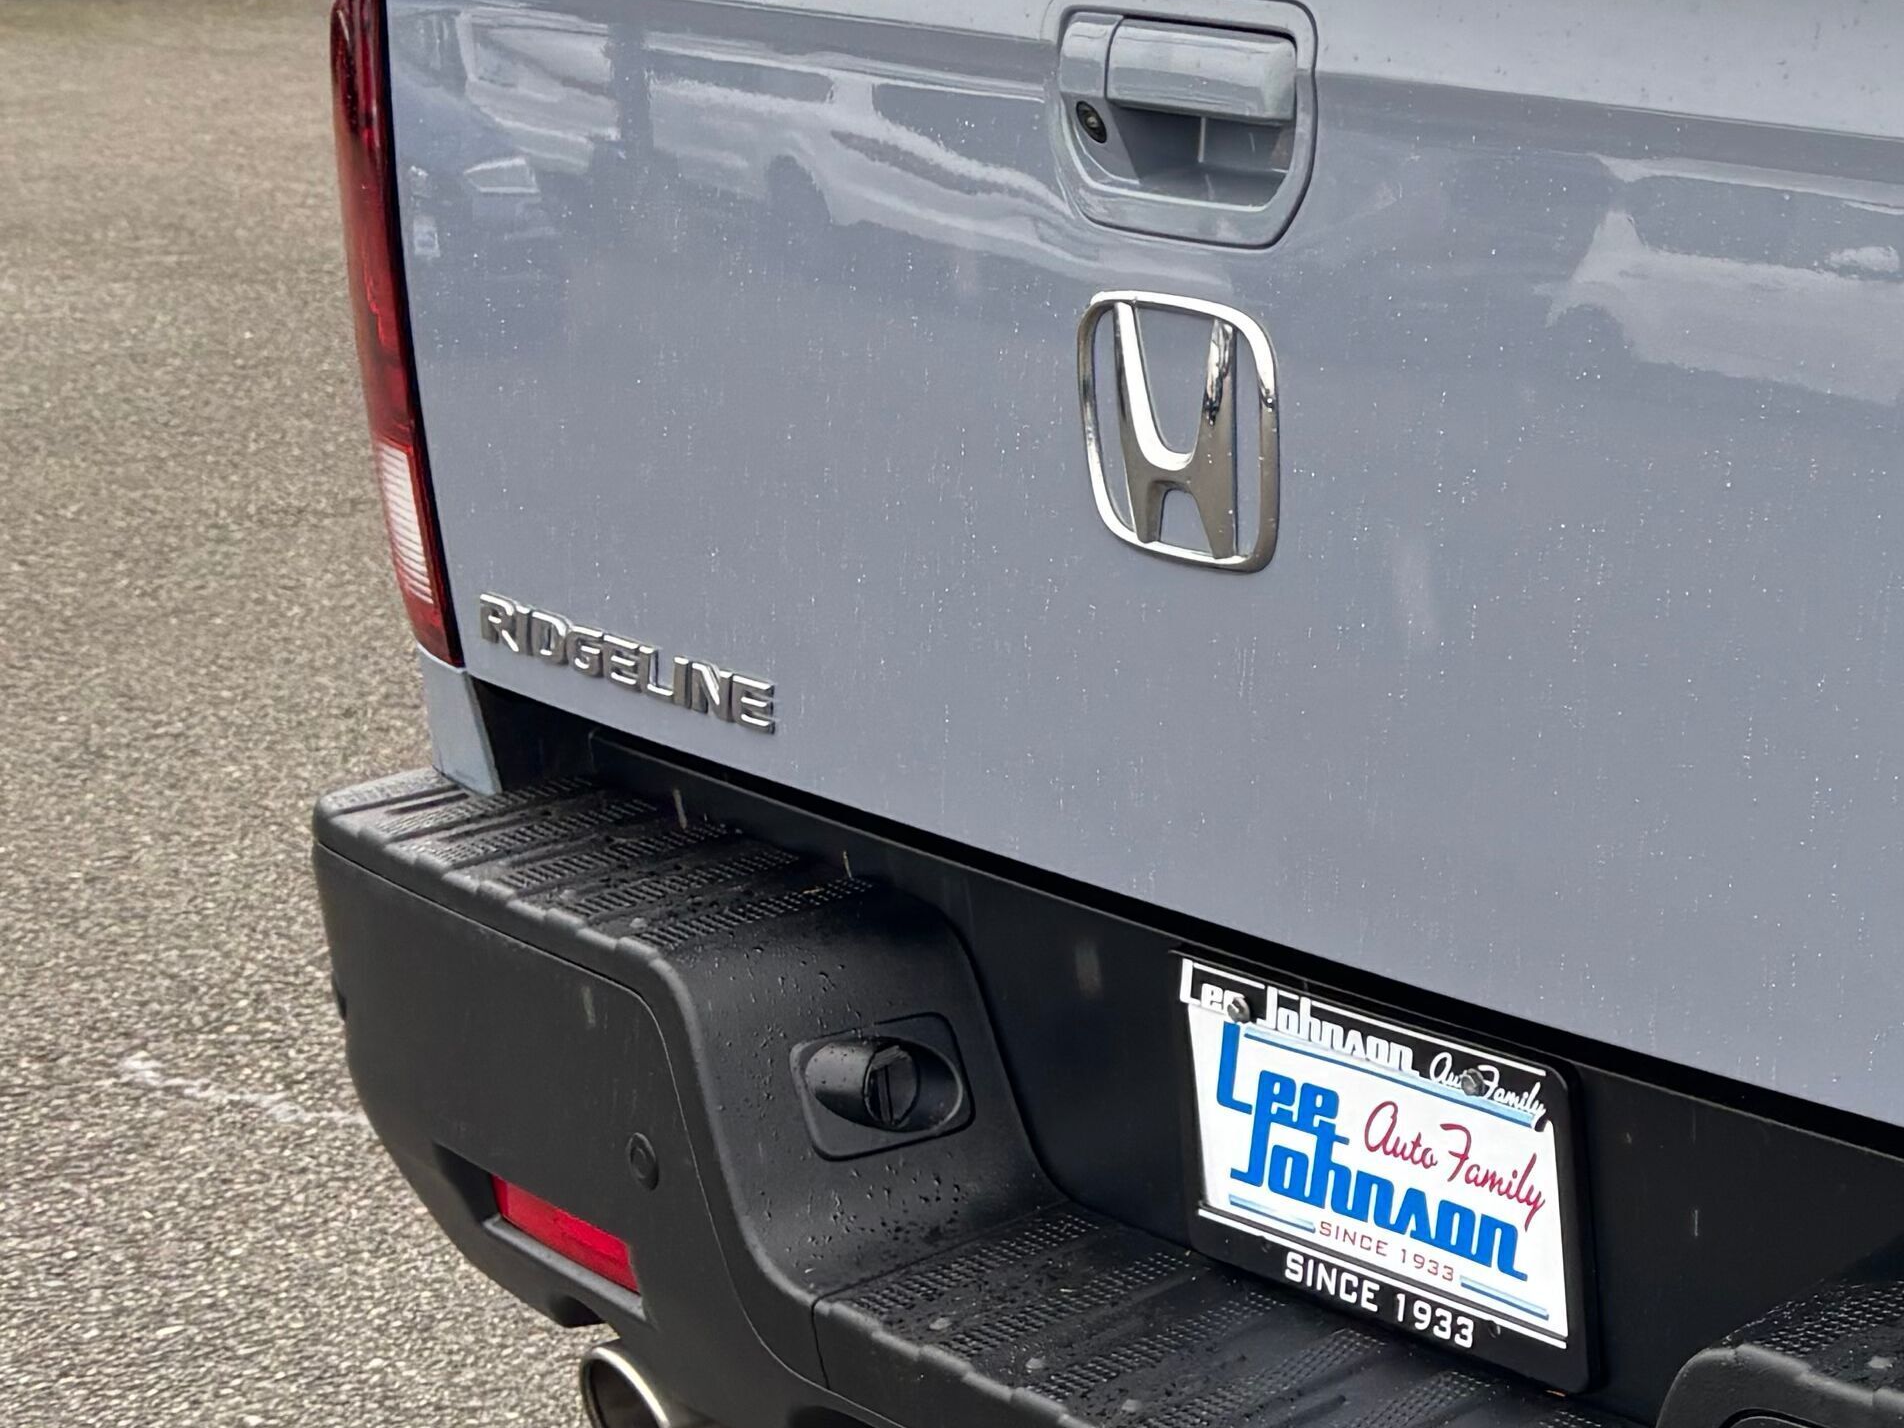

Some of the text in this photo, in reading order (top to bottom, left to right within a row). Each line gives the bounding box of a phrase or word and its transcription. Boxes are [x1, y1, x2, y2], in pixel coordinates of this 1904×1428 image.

[480, 592, 775, 735] RIDGELINE
[1216, 1023, 1546, 1232] Lee Auto Family
[1256, 985, 1420, 1078] Johnson
[1477, 1064, 1547, 1132] Family
[1230, 1117, 1528, 1282] Johnson
[1318, 1220, 1456, 1283] SINCE 1933
[1284, 1252, 1475, 1349] SINCE 1933
